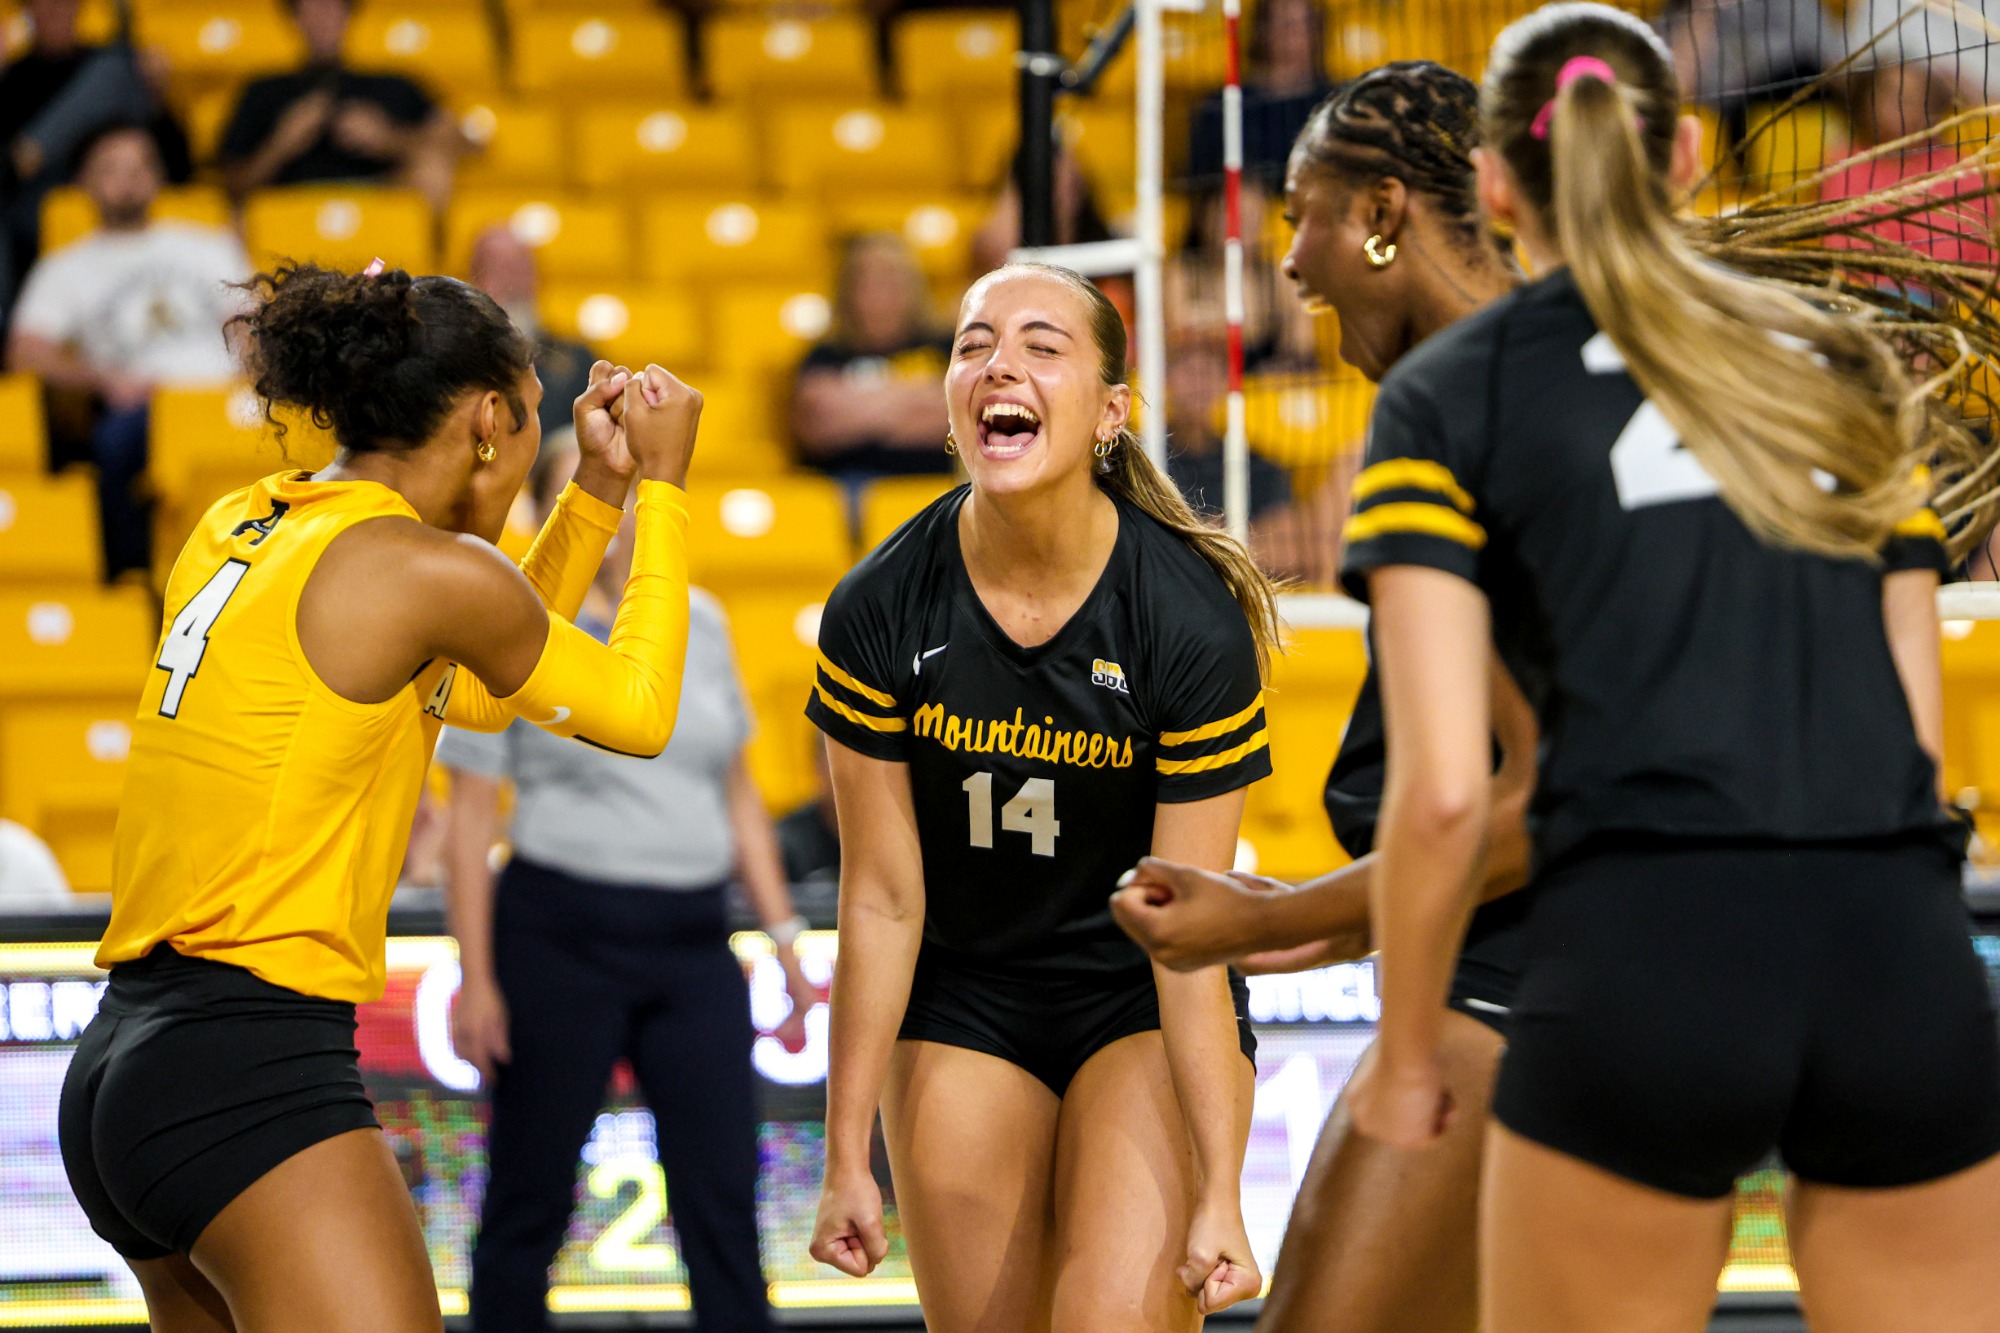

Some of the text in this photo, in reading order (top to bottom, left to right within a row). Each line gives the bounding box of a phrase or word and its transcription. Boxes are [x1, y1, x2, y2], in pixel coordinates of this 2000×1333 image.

[157, 557, 251, 719] 4
[914, 703, 1133, 768] Mountaineers
[962, 771, 1060, 857] 14
[588, 1157, 677, 1271] 2
